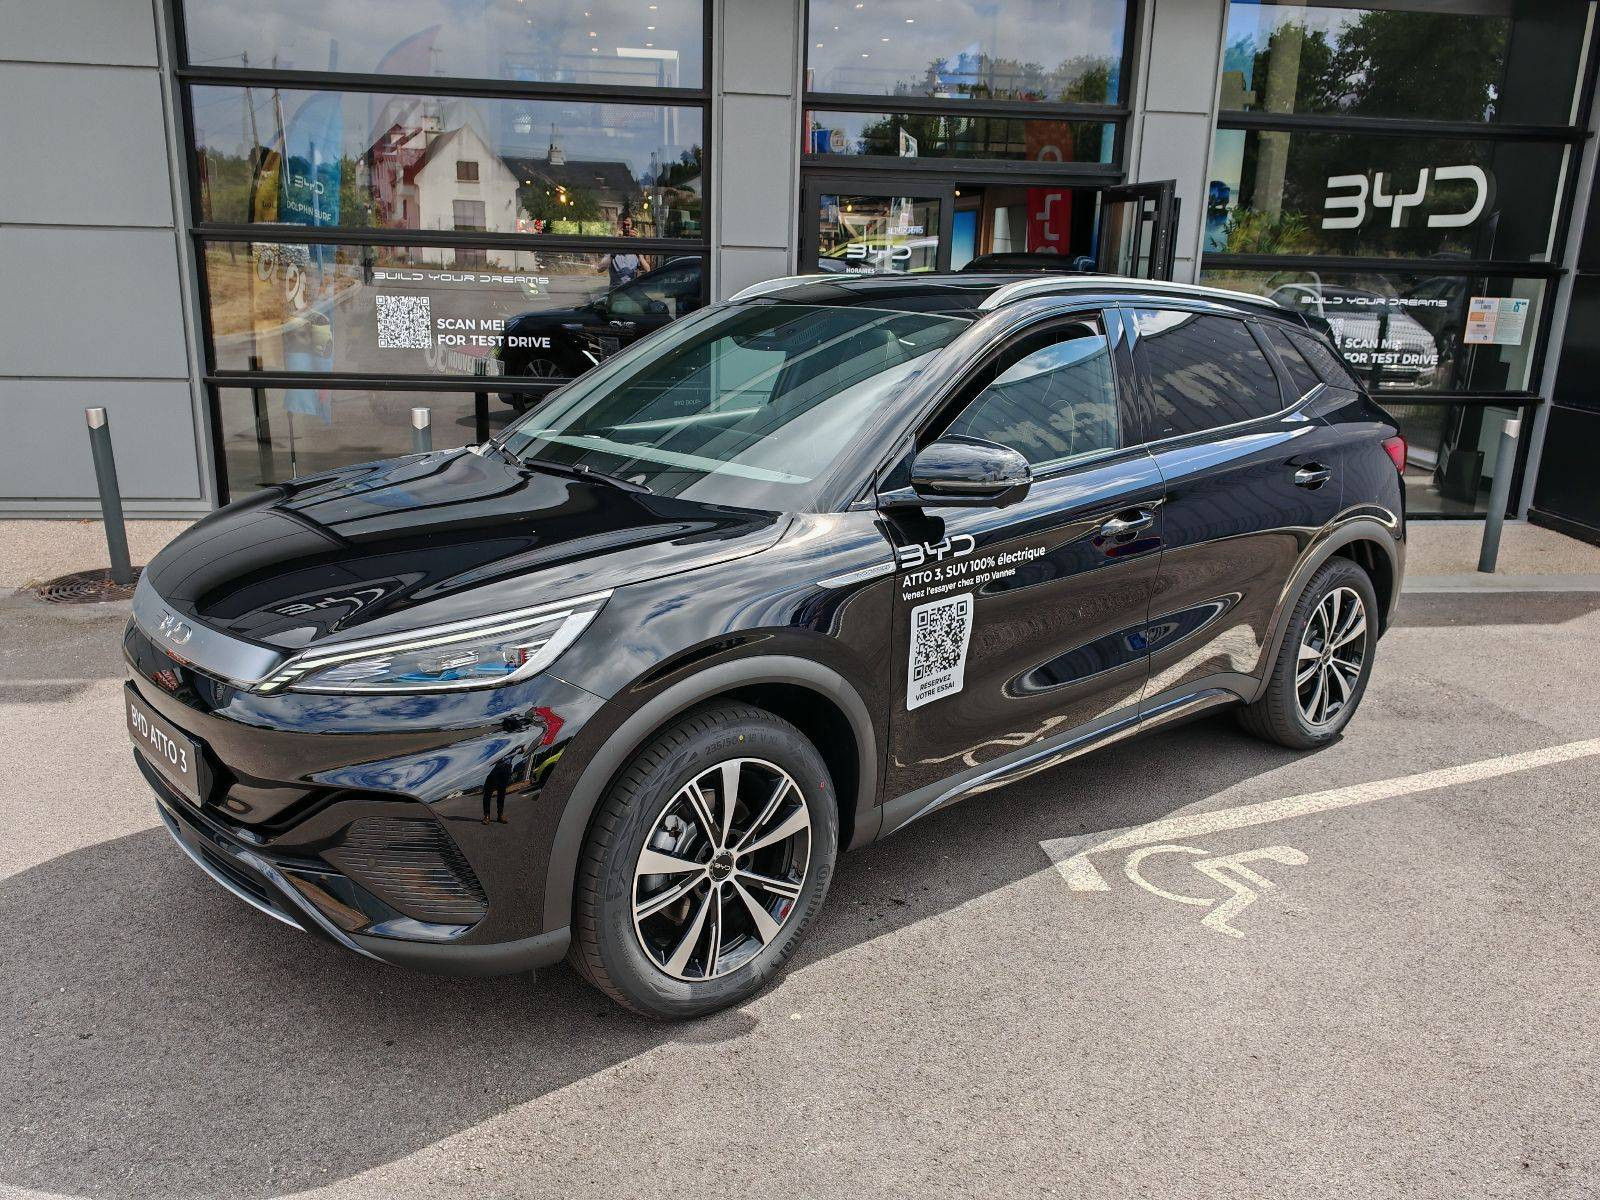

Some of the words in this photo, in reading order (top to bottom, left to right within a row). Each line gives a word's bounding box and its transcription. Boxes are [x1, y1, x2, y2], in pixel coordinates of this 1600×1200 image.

[294, 175, 324, 195] BYD
[1322, 165, 1487, 229] BYD
[286, 200, 313, 216] DOLPHIN
[314, 209, 332, 221] SURF
[847, 243, 912, 259] BYD
[374, 272, 424, 280] BUILD
[428, 273, 475, 282] YOUR
[480, 275, 549, 284] DREAMS
[1301, 296, 1343, 304] BUILD
[1346, 297, 1386, 306] YOUR
[1389, 297, 1448, 308] DREAMS
[437, 318, 476, 330] SCAN
[480, 319, 505, 331] ME!
[438, 334, 466, 346] FOR
[470, 335, 504, 347] TEST
[508, 336, 551, 348] DRIVE
[1345, 338, 1378, 349] SCAN
[1371, 353, 1401, 364] TEST
[1402, 354, 1439, 365] DRIVE
[898, 534, 976, 569] BYD
[902, 571, 932, 588] ATTO
[934, 568, 944, 582] 3,
[946, 563, 968, 578] SUV
[970, 556, 996, 572] 100%
[997, 546, 1046, 566] électrique
[902, 591, 925, 601] Venez
[926, 582, 957, 596] l'essayer
[957, 577, 974, 588] chez
[975, 573, 990, 584] BYD
[991, 567, 1016, 580] Vannes
[915, 688, 936, 701] VOTRE
[936, 681, 955, 693] ESSAI
[131, 703, 148, 738] BYD
[150, 724, 178, 764] ATTO
[180, 747, 187, 773] 3
